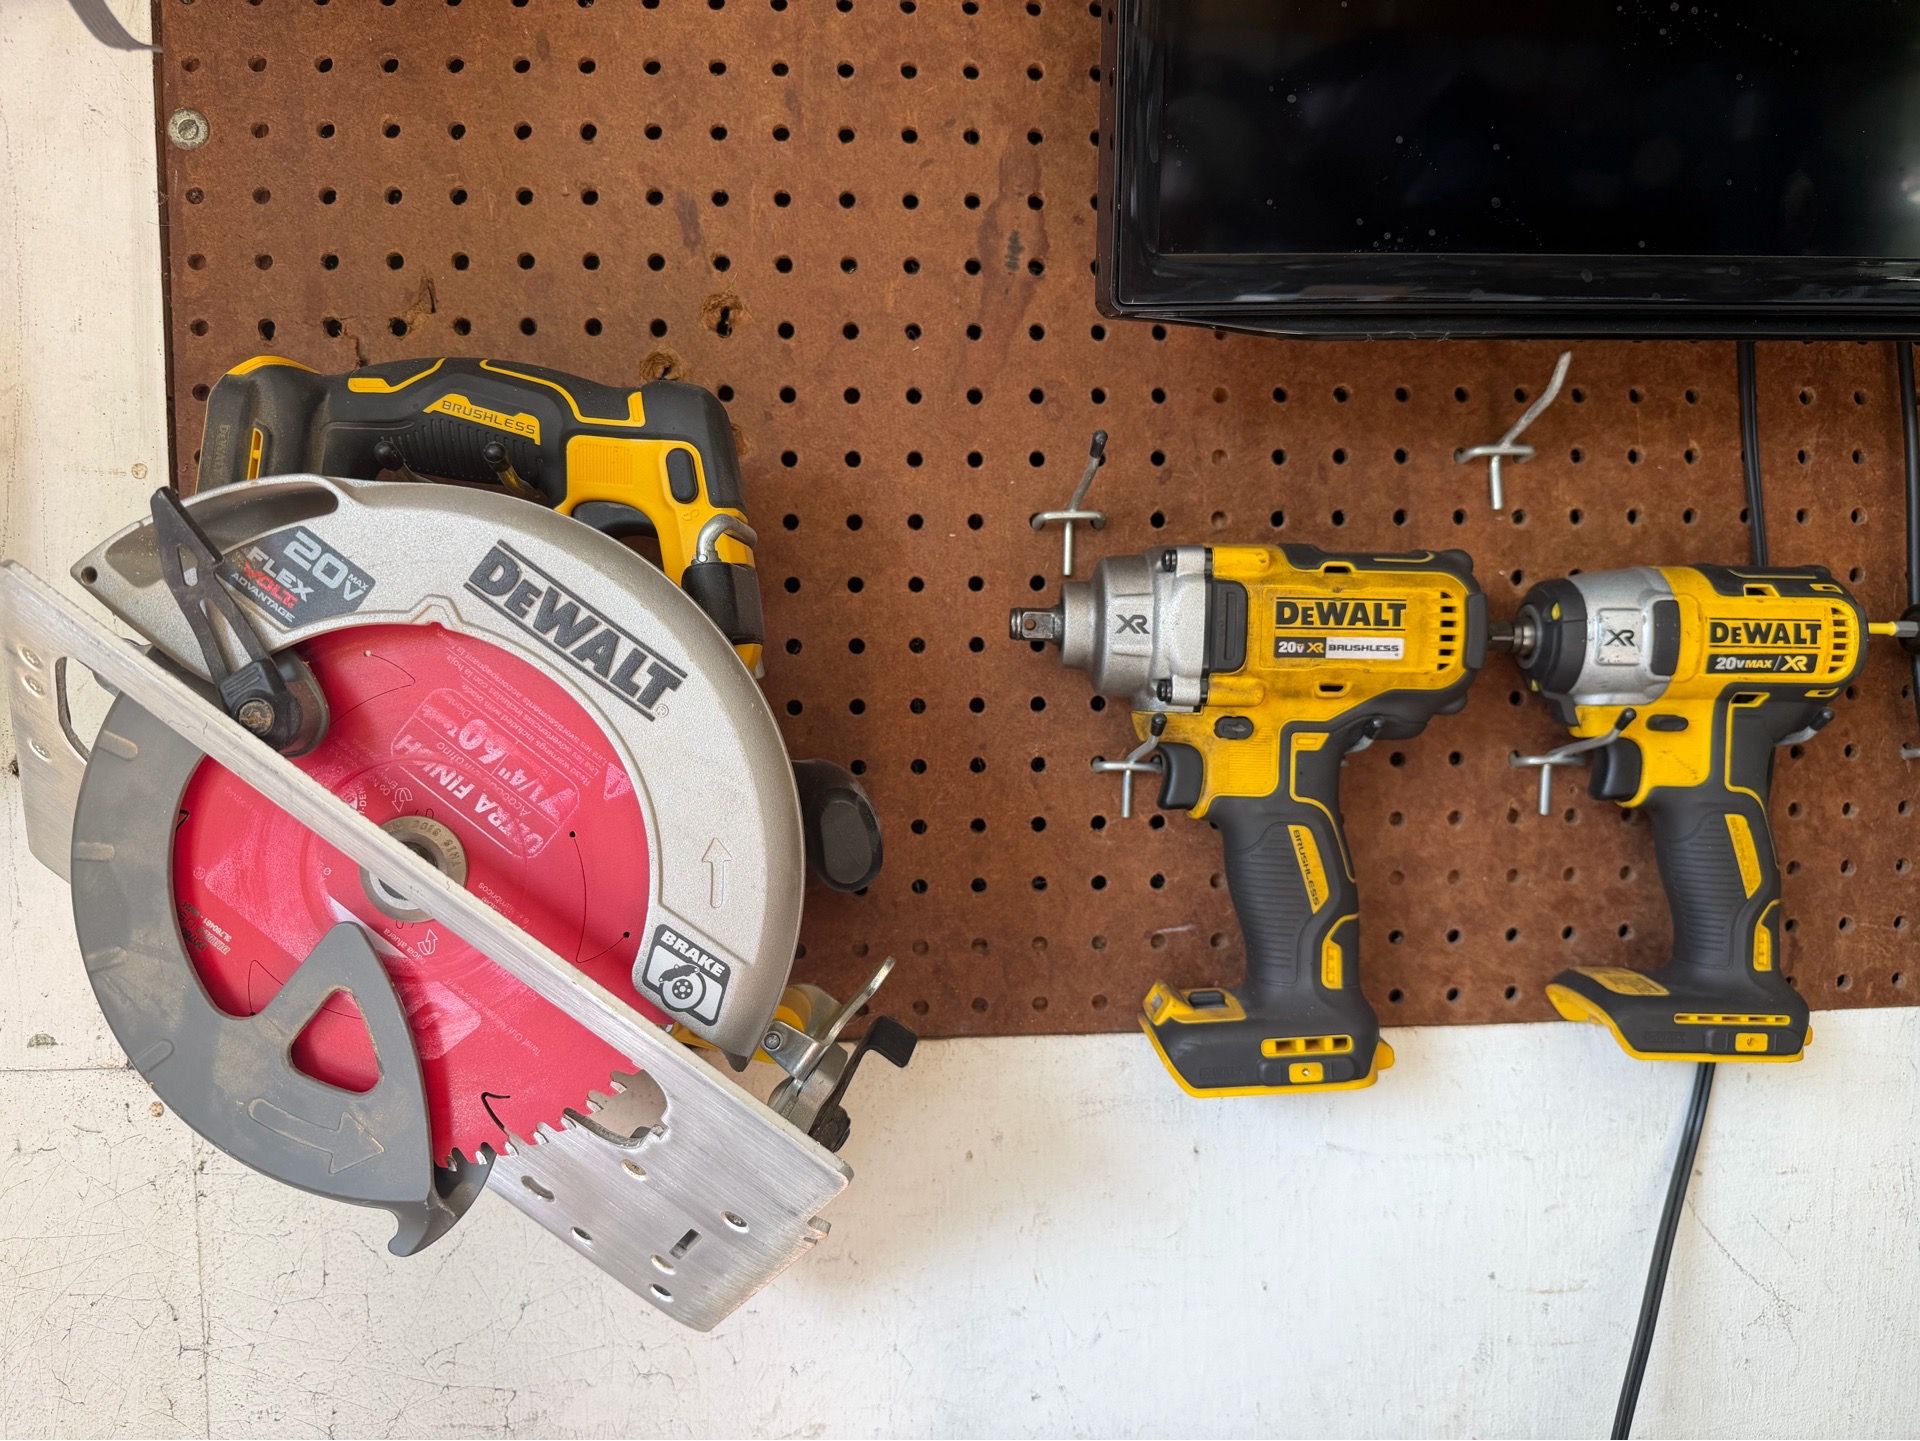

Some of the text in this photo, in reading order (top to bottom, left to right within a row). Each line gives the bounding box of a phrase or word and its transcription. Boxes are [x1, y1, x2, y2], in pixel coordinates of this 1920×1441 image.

[441, 400, 538, 436] BRUSHLESS
[245, 549, 313, 602] FLEX
[347, 573, 369, 591] MAX
[231, 574, 295, 622] ADVANTAGE
[1115, 613, 1149, 635] XR
[1306, 641, 1324, 653] XR
[1328, 644, 1399, 652] BRUSHLESS
[1604, 629, 1636, 647] XR
[462, 667, 473, 678] la
[1780, 655, 1808, 671] XR
[453, 713, 506, 764] 60
[499, 713, 535, 743] included
[1293, 829, 1320, 906] BRUSHLESS
[381, 926, 408, 950] afuera
[660, 930, 726, 977] BRAKE
